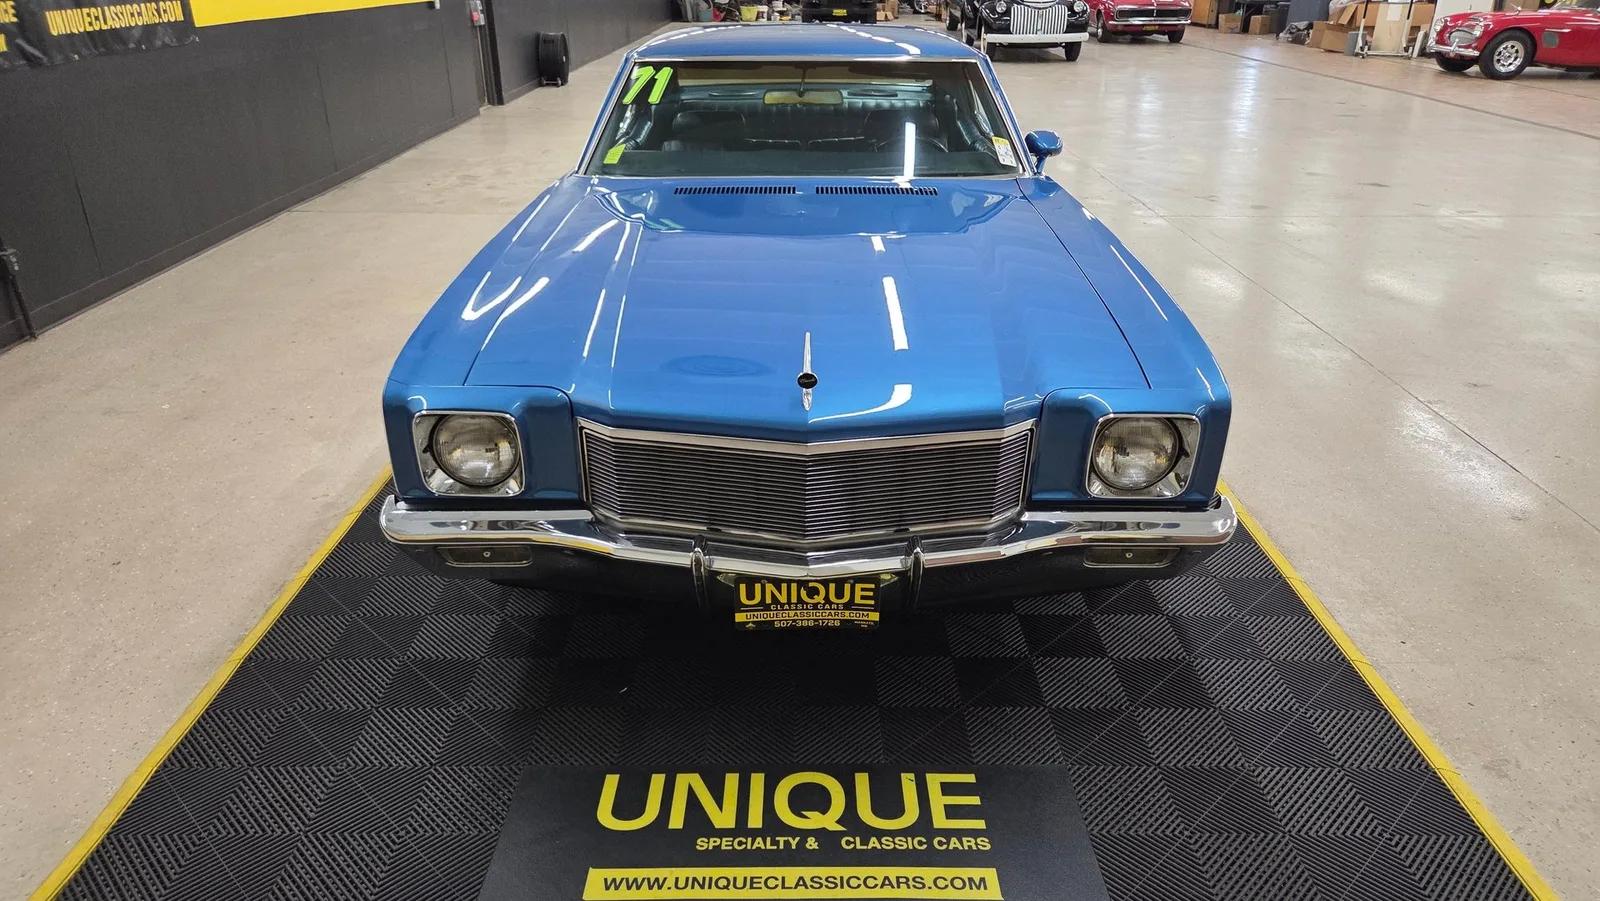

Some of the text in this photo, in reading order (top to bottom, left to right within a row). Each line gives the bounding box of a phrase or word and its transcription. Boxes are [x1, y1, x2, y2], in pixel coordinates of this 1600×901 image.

[45, 1, 184, 36] UNIQUECLASSICCARS.COM
[622, 66, 673, 105] 71
[739, 582, 875, 605] UNIQUE
[745, 611, 870, 620] UNIQUECLASSICCARS.COM
[597, 772, 987, 831] UNIQUE
[696, 837, 991, 850] SPECIALTY & CLASSIC CARS
[603, 875, 988, 891] WWW.UNIQUECLASSICCARS.COM
